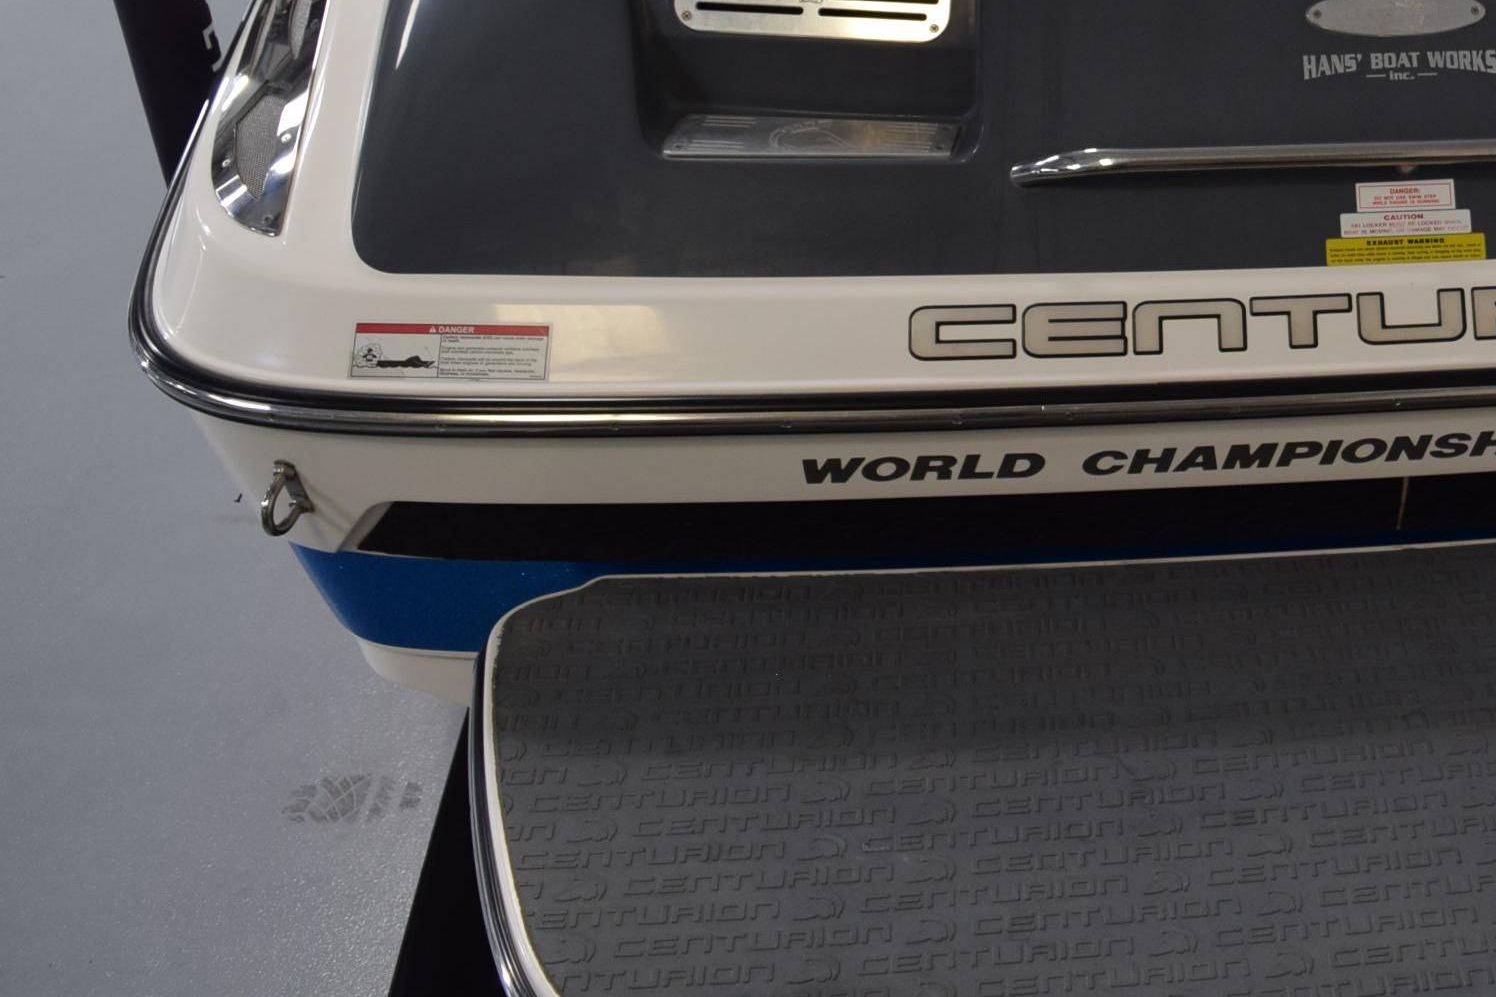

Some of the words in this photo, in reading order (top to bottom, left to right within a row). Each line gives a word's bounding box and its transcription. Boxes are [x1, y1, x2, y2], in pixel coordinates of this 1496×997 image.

[1302, 52, 1362, 80] HANS'
[1370, 51, 1420, 69] BOAT
[1383, 213, 1424, 221] CAUTION
[1366, 238, 1404, 246] EXHAUST
[1407, 237, 1445, 245] WARNING
[438, 326, 475, 334] DANGER
[801, 452, 1046, 485] WORLD
